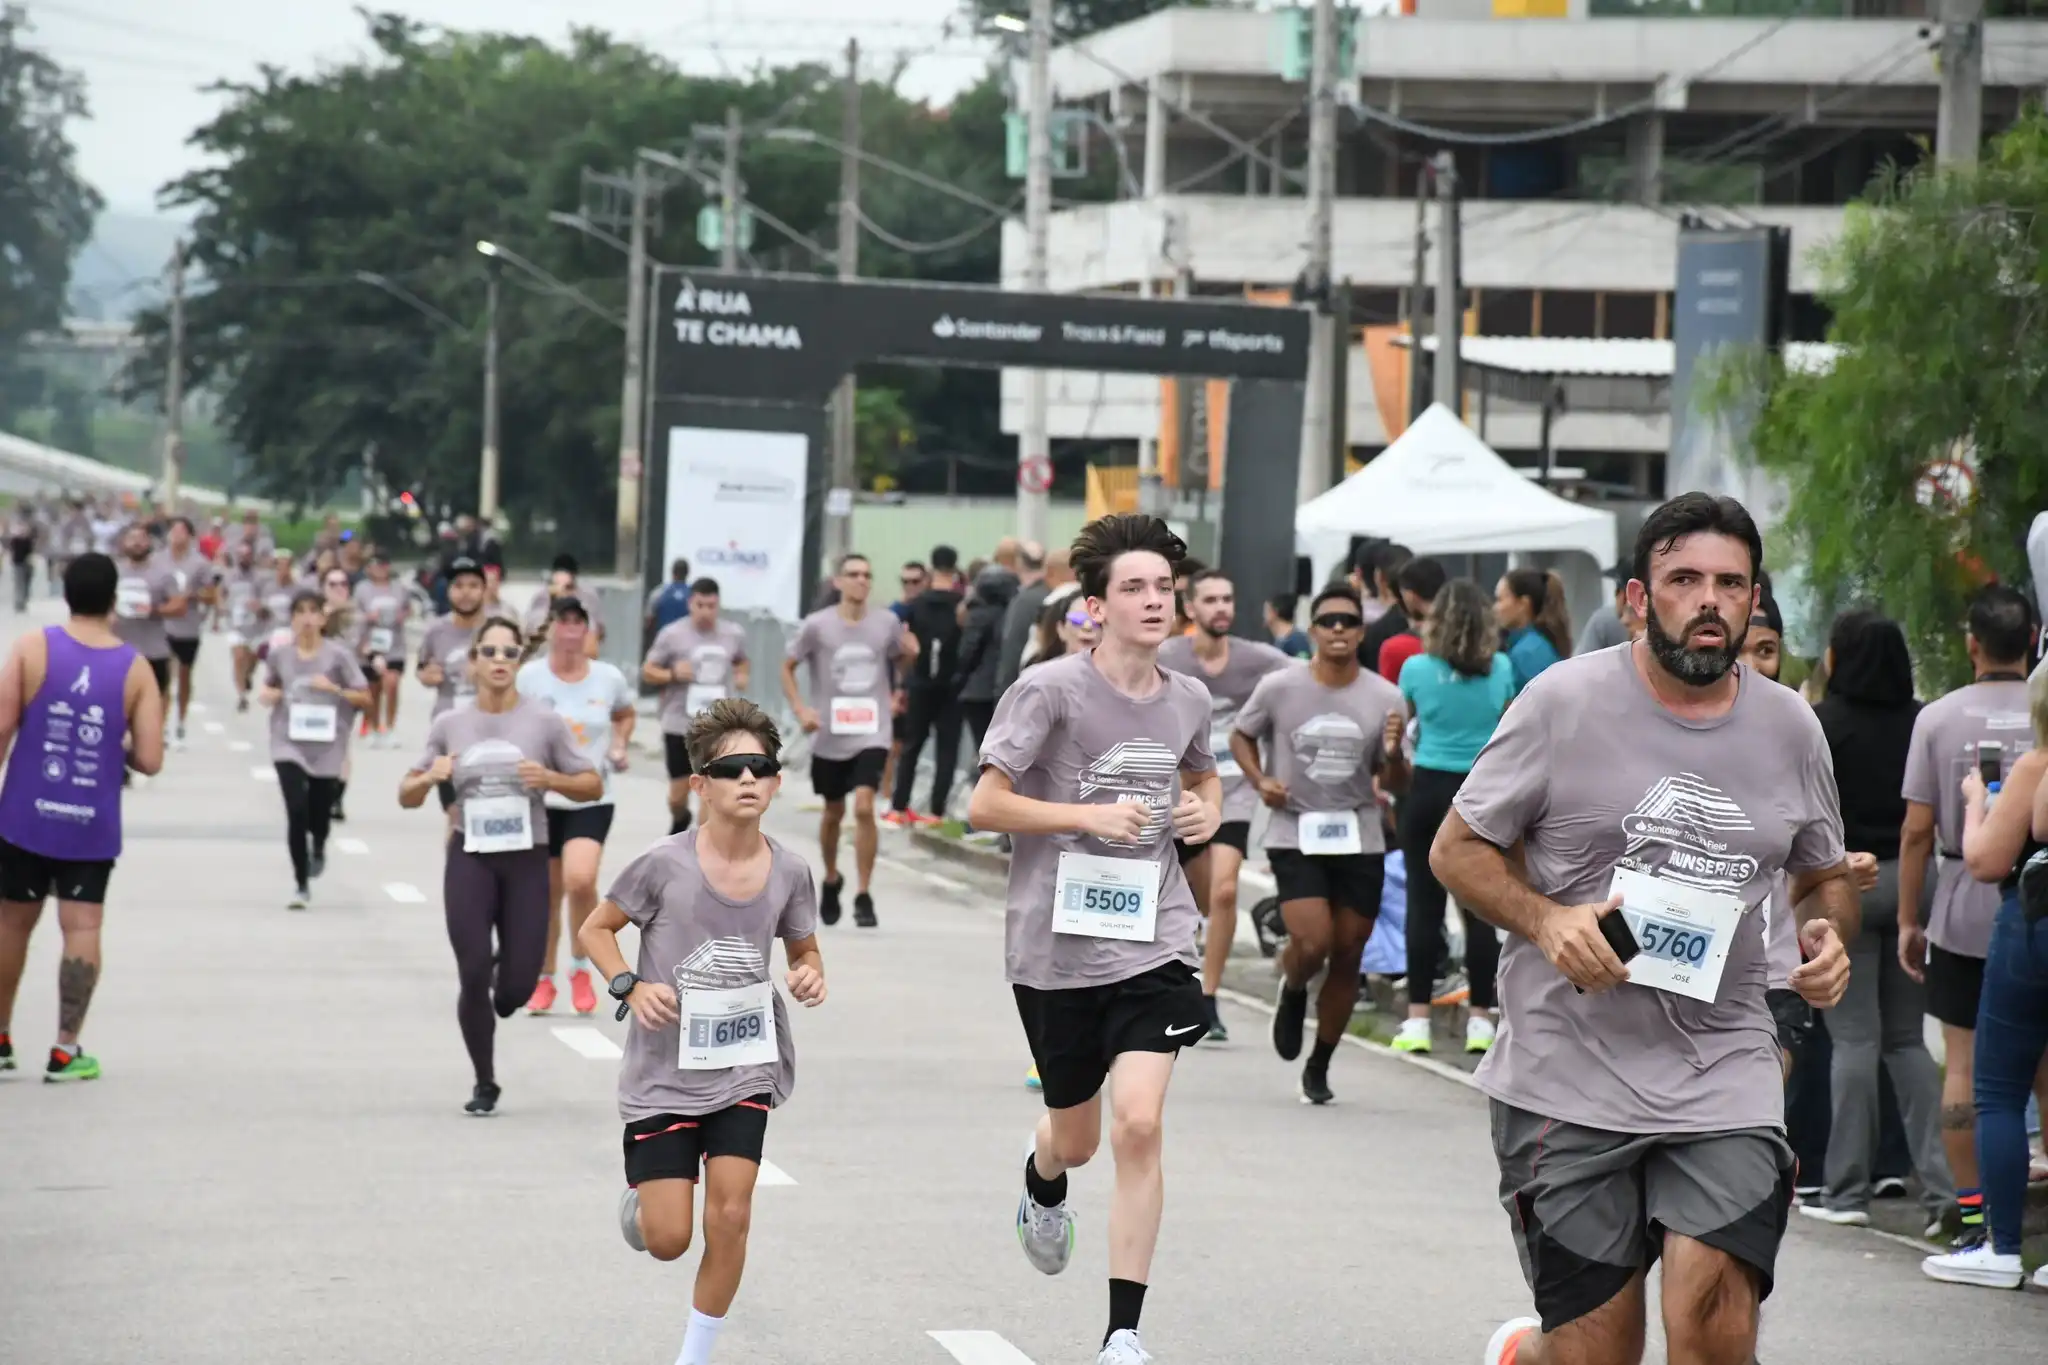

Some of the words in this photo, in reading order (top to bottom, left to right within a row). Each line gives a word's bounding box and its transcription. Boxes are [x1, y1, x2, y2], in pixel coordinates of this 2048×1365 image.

[698, 289, 752, 315] RUA
[673, 318, 704, 344] TE
[706, 321, 802, 350] CHAMA
[955, 321, 1043, 342] Santander
[1621, 857, 1653, 874] COLINAS
[1667, 850, 1751, 879] RUNSERIES
[1084, 888, 1141, 914] 5509
[1641, 922, 1707, 962] 5760
[1671, 973, 1691, 984] JOSÉ
[715, 1014, 761, 1043] 6169
